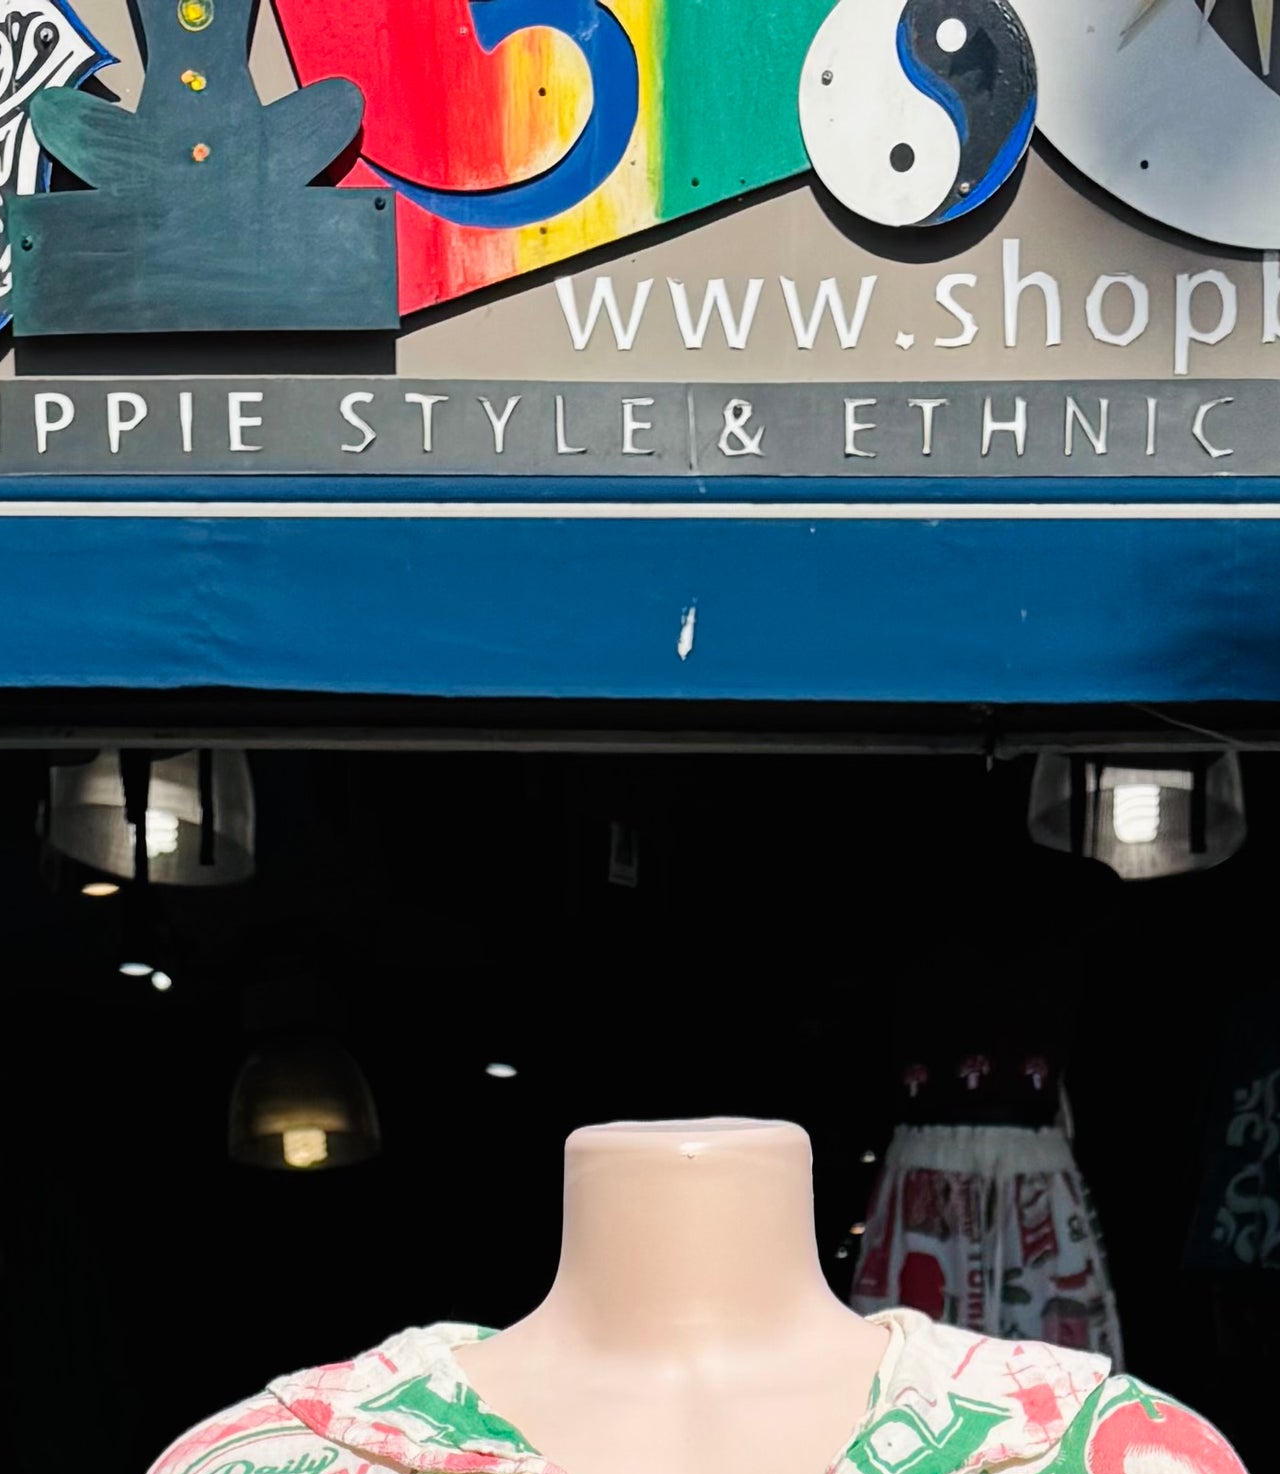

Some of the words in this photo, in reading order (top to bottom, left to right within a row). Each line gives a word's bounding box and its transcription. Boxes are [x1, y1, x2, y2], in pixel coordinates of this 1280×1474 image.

[339, 391, 657, 456] STYLE
[720, 399, 766, 460] &
[844, 396, 1237, 460] ETHNIC
